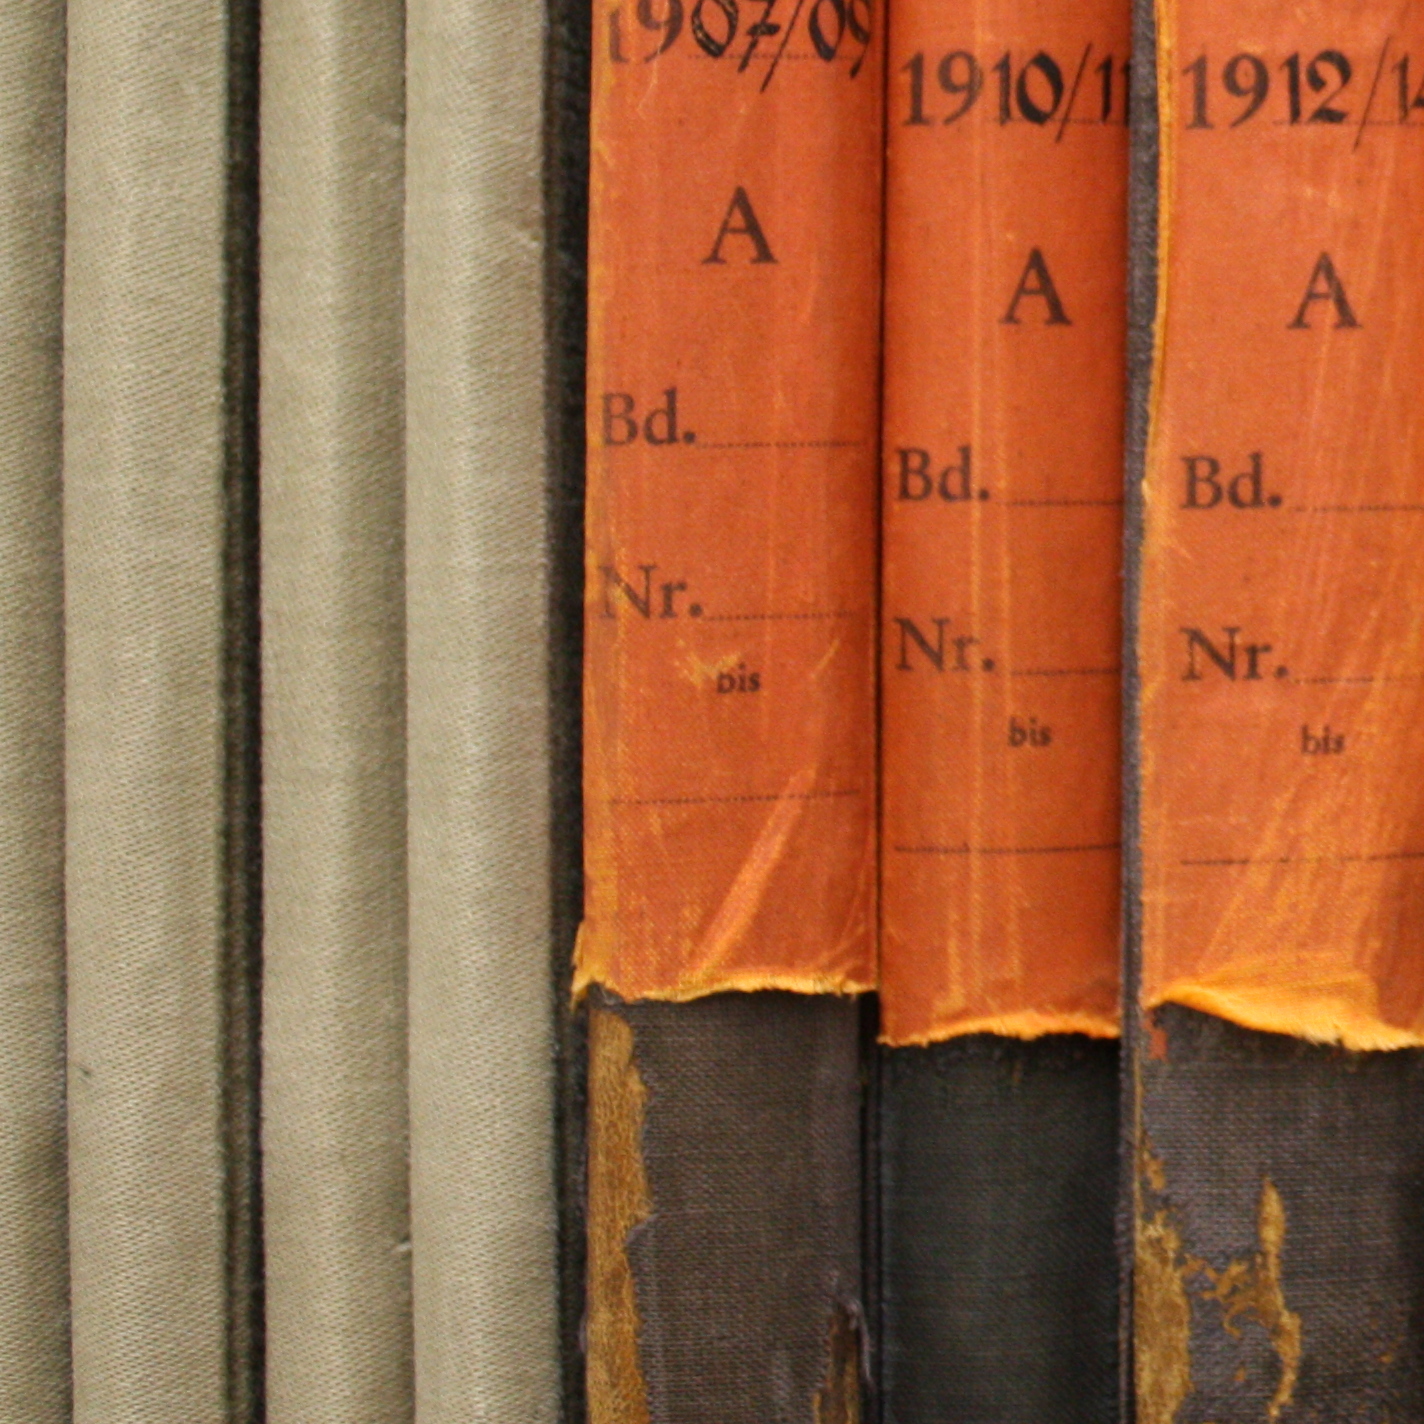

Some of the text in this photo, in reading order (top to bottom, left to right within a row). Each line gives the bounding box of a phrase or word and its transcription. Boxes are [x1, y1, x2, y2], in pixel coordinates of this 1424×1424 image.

[701, 186, 778, 265] A
[1000, 247, 1072, 326] A
[1287, 250, 1362, 330] A
[601, 387, 697, 446] Bd.
[896, 446, 991, 503] Bd.
[1180, 451, 1283, 510] Bd.
[599, 564, 704, 620] Nr.
[894, 617, 995, 672] Nr.
[1180, 627, 1289, 683] Nr.
[716, 663, 762, 695] bis
[1008, 716, 1052, 747] bis
[1301, 726, 1345, 756] bis
